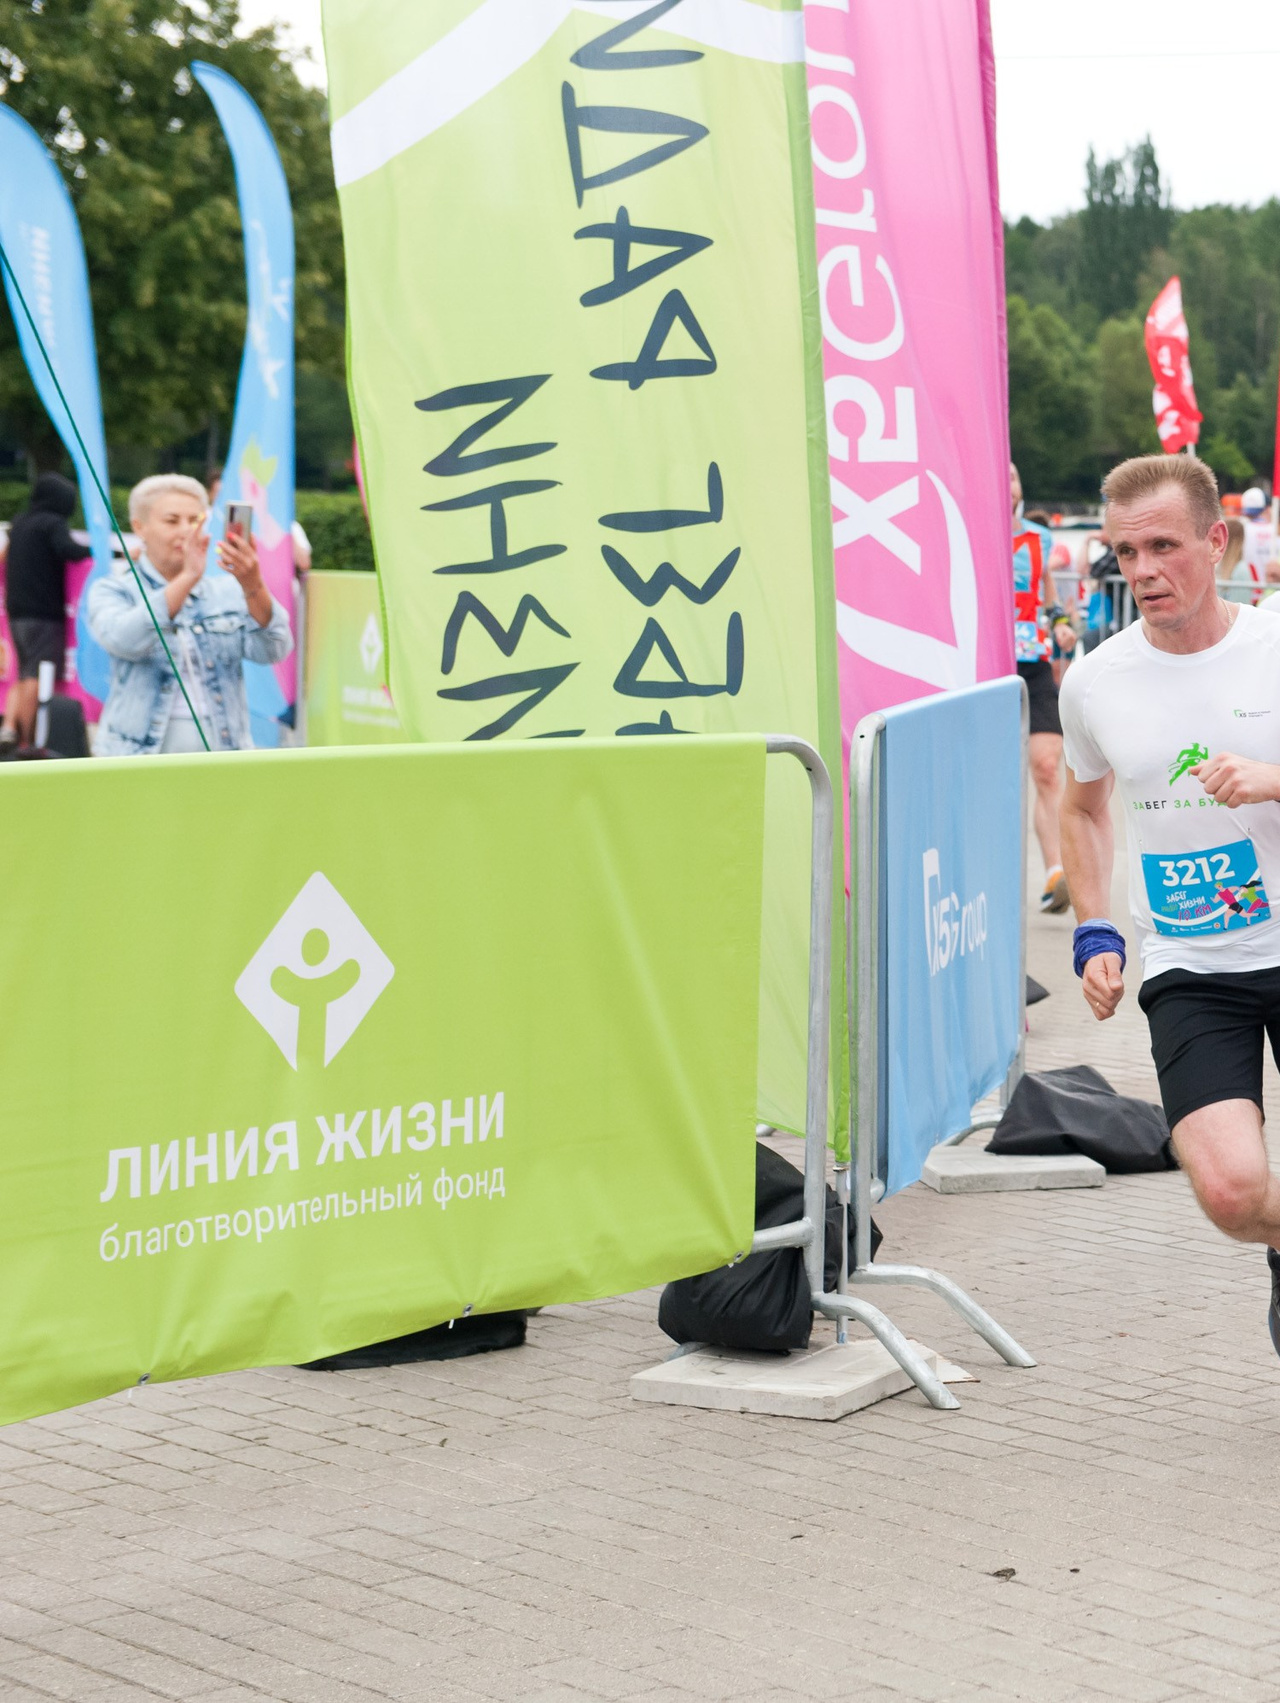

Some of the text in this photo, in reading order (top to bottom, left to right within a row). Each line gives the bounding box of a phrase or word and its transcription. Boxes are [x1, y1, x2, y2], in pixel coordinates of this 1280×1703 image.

[1132, 800, 1167, 810] ЗАБЕГ
[1174, 799, 1192, 809] ЗА
[1159, 853, 1236, 887] 3212
[1178, 909, 1191, 922] 10
[100, 1091, 505, 1203] ЛИНИЯ ЖИЗНИ
[99, 1167, 507, 1263] благотворительный фонд
